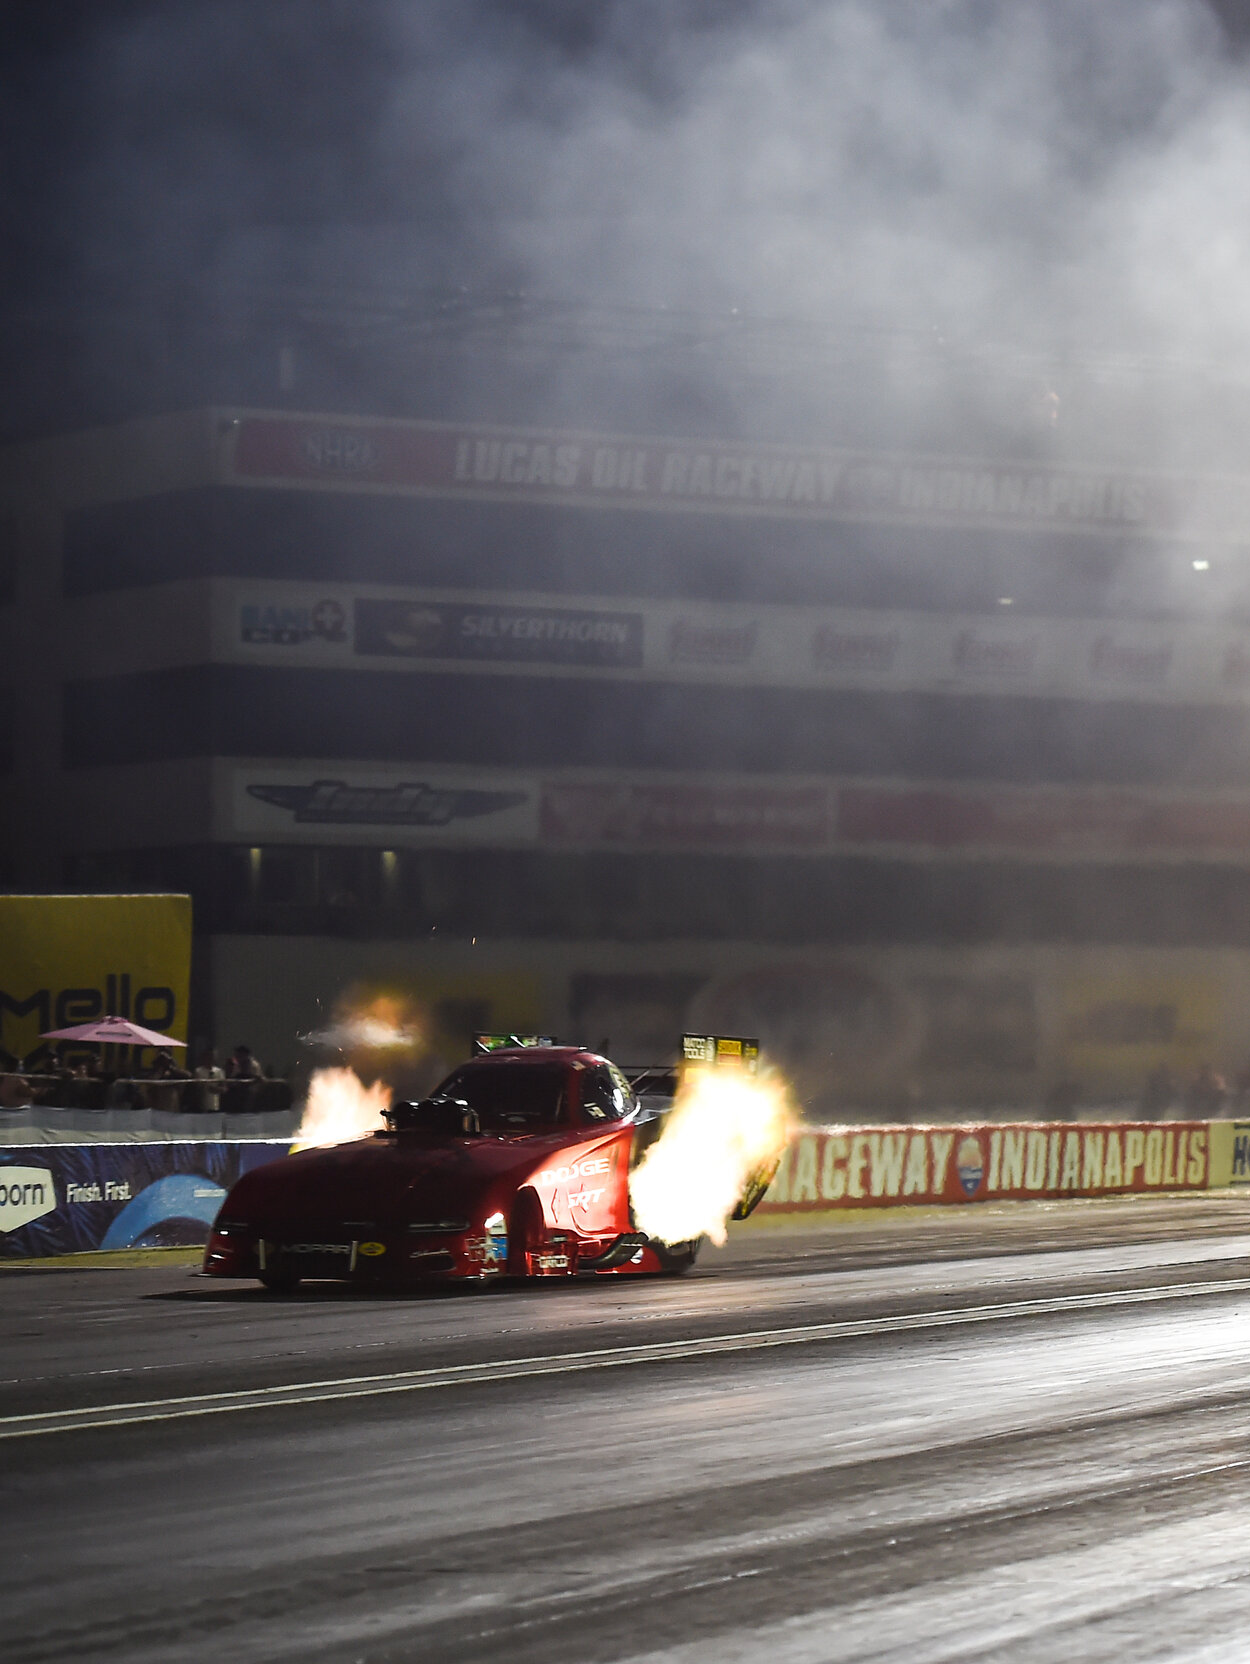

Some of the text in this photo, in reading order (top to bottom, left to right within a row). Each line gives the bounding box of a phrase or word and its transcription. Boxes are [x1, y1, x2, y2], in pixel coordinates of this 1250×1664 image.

[455, 437, 579, 487] LUCAS
[590, 446, 648, 492] OIL
[660, 449, 841, 504] RACEWAY
[460, 614, 629, 644] SILVERTHORN
[540, 1158, 610, 1187] DODGE
[987, 1130, 1207, 1192] INDIANAPOLIS
[66, 1181, 132, 1204] Finish. First.
